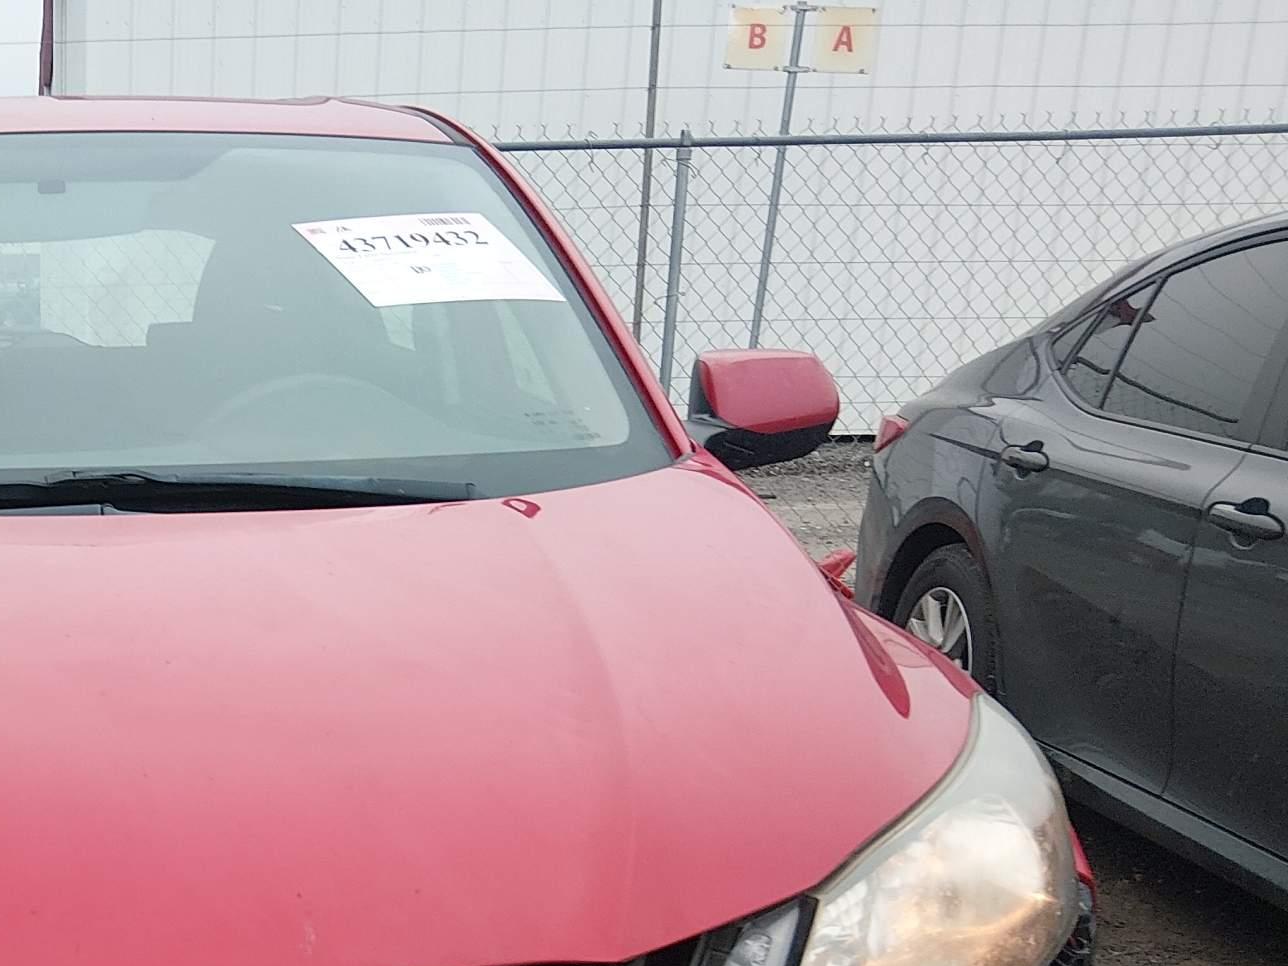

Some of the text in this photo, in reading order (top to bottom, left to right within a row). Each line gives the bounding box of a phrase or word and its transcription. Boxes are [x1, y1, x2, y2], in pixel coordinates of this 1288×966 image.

[748, 23, 767, 49] B
[832, 25, 854, 52] A
[339, 230, 489, 253] 43719432
